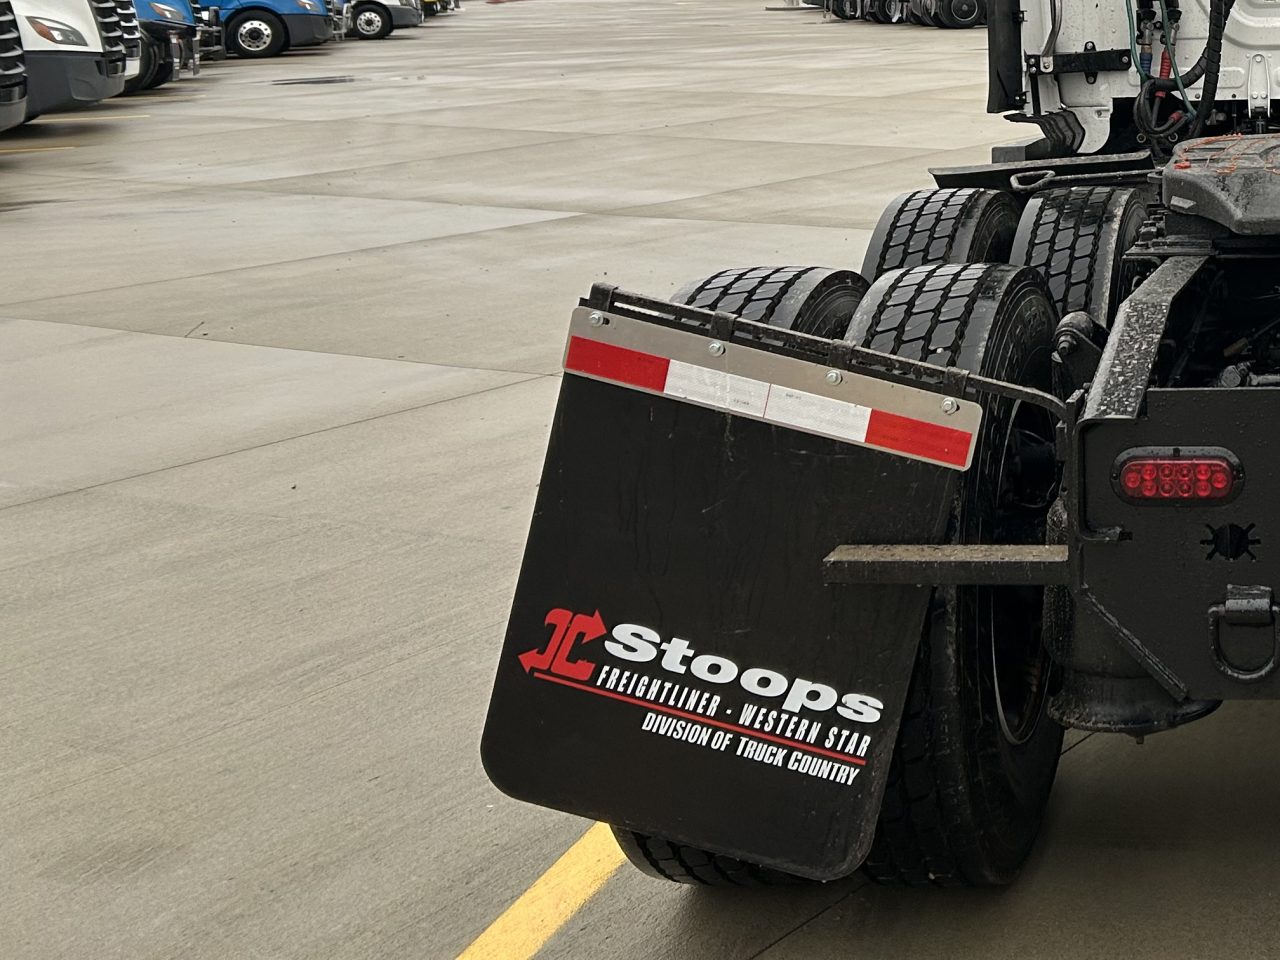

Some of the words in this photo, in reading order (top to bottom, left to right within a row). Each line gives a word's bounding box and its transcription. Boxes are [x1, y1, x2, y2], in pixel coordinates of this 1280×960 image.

[596, 665, 721, 717] FREIGHTLINER
[738, 703, 822, 744] WESTERN
[824, 726, 872, 758] STAR
[604, 623, 884, 723] Stoops
[641, 712, 713, 747] DIVISION
[710, 730, 734, 752] OF
[735, 736, 788, 767] TRUCK
[787, 750, 861, 786] COUNTRY
